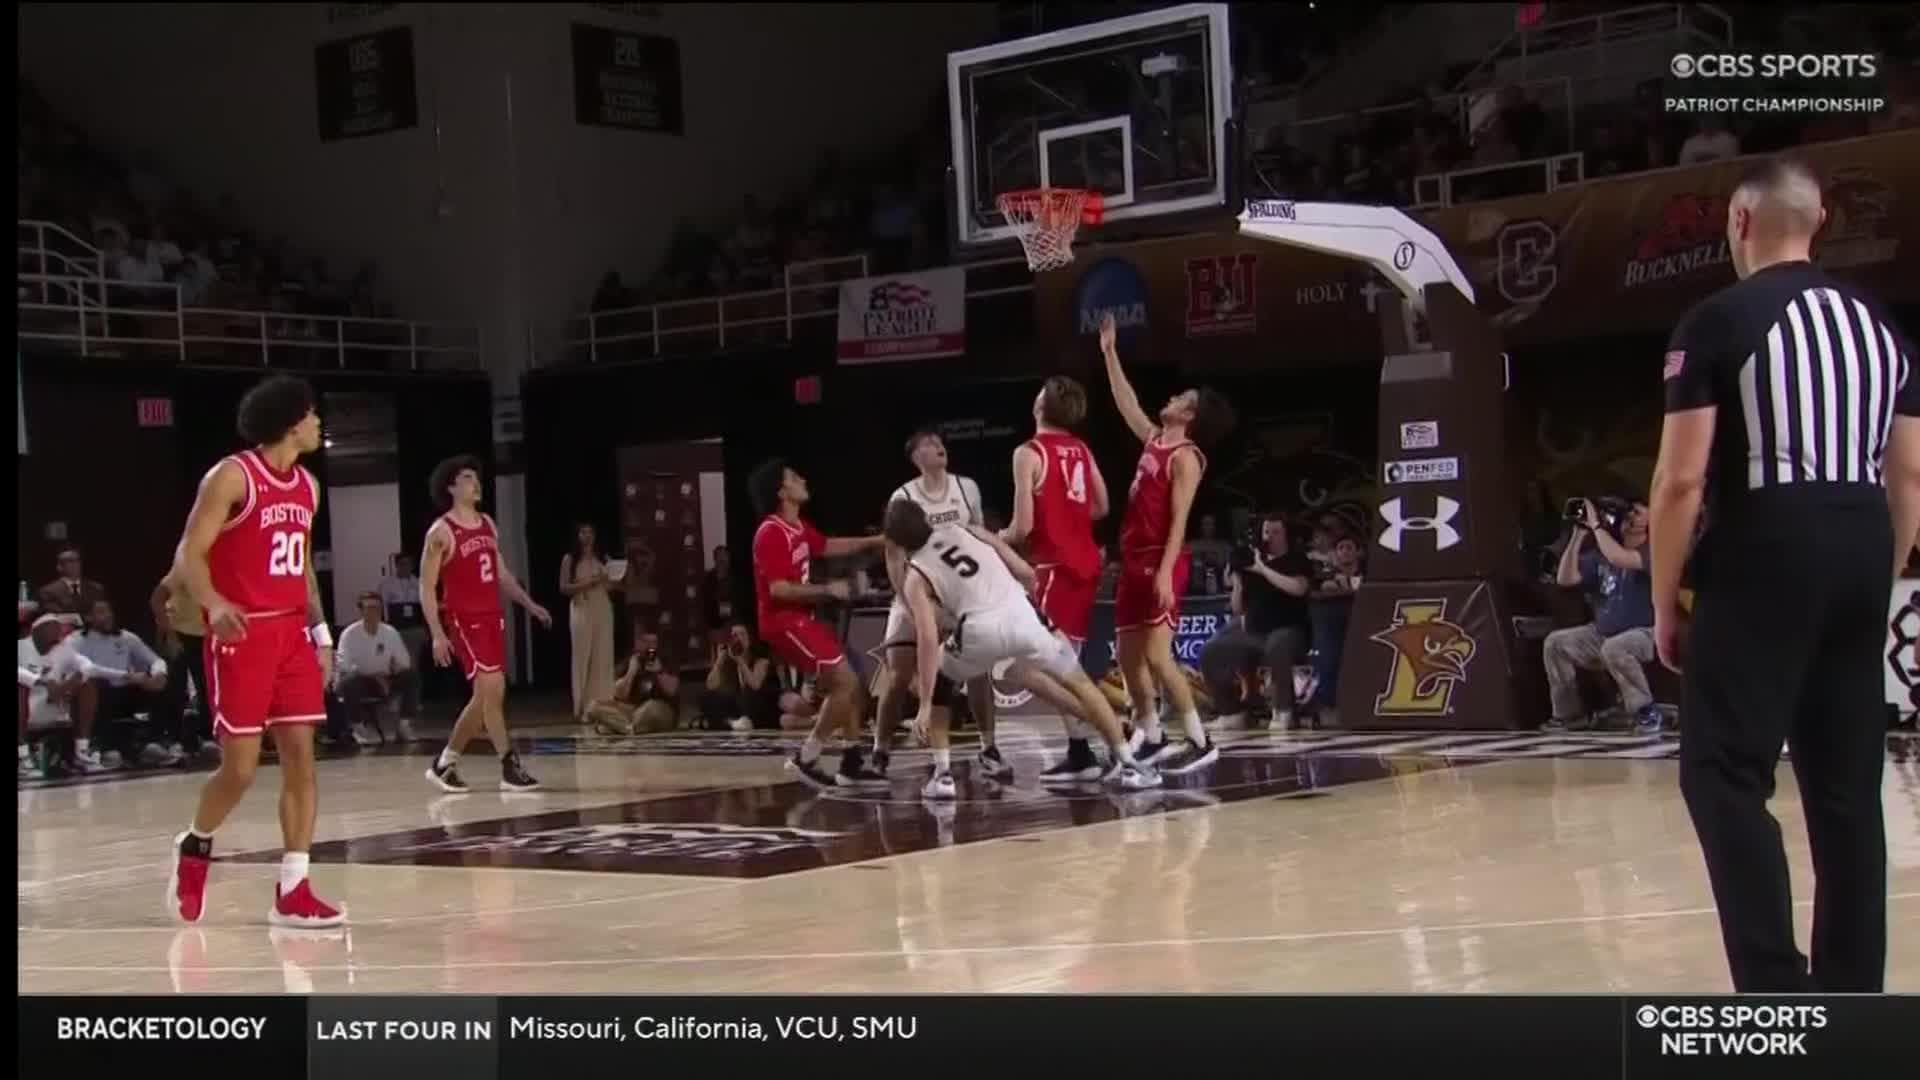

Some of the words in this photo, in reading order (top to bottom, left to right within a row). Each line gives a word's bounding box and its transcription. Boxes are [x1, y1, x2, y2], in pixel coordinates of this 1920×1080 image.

[1248, 201, 1296, 220] SPALDING
[1296, 281, 1357, 305] HOLY
[1406, 461, 1455, 475] PENFED
[260, 502, 313, 530] BOSTON
[268, 531, 305, 576] 20
[940, 544, 980, 578] 5
[479, 553, 494, 584] 2
